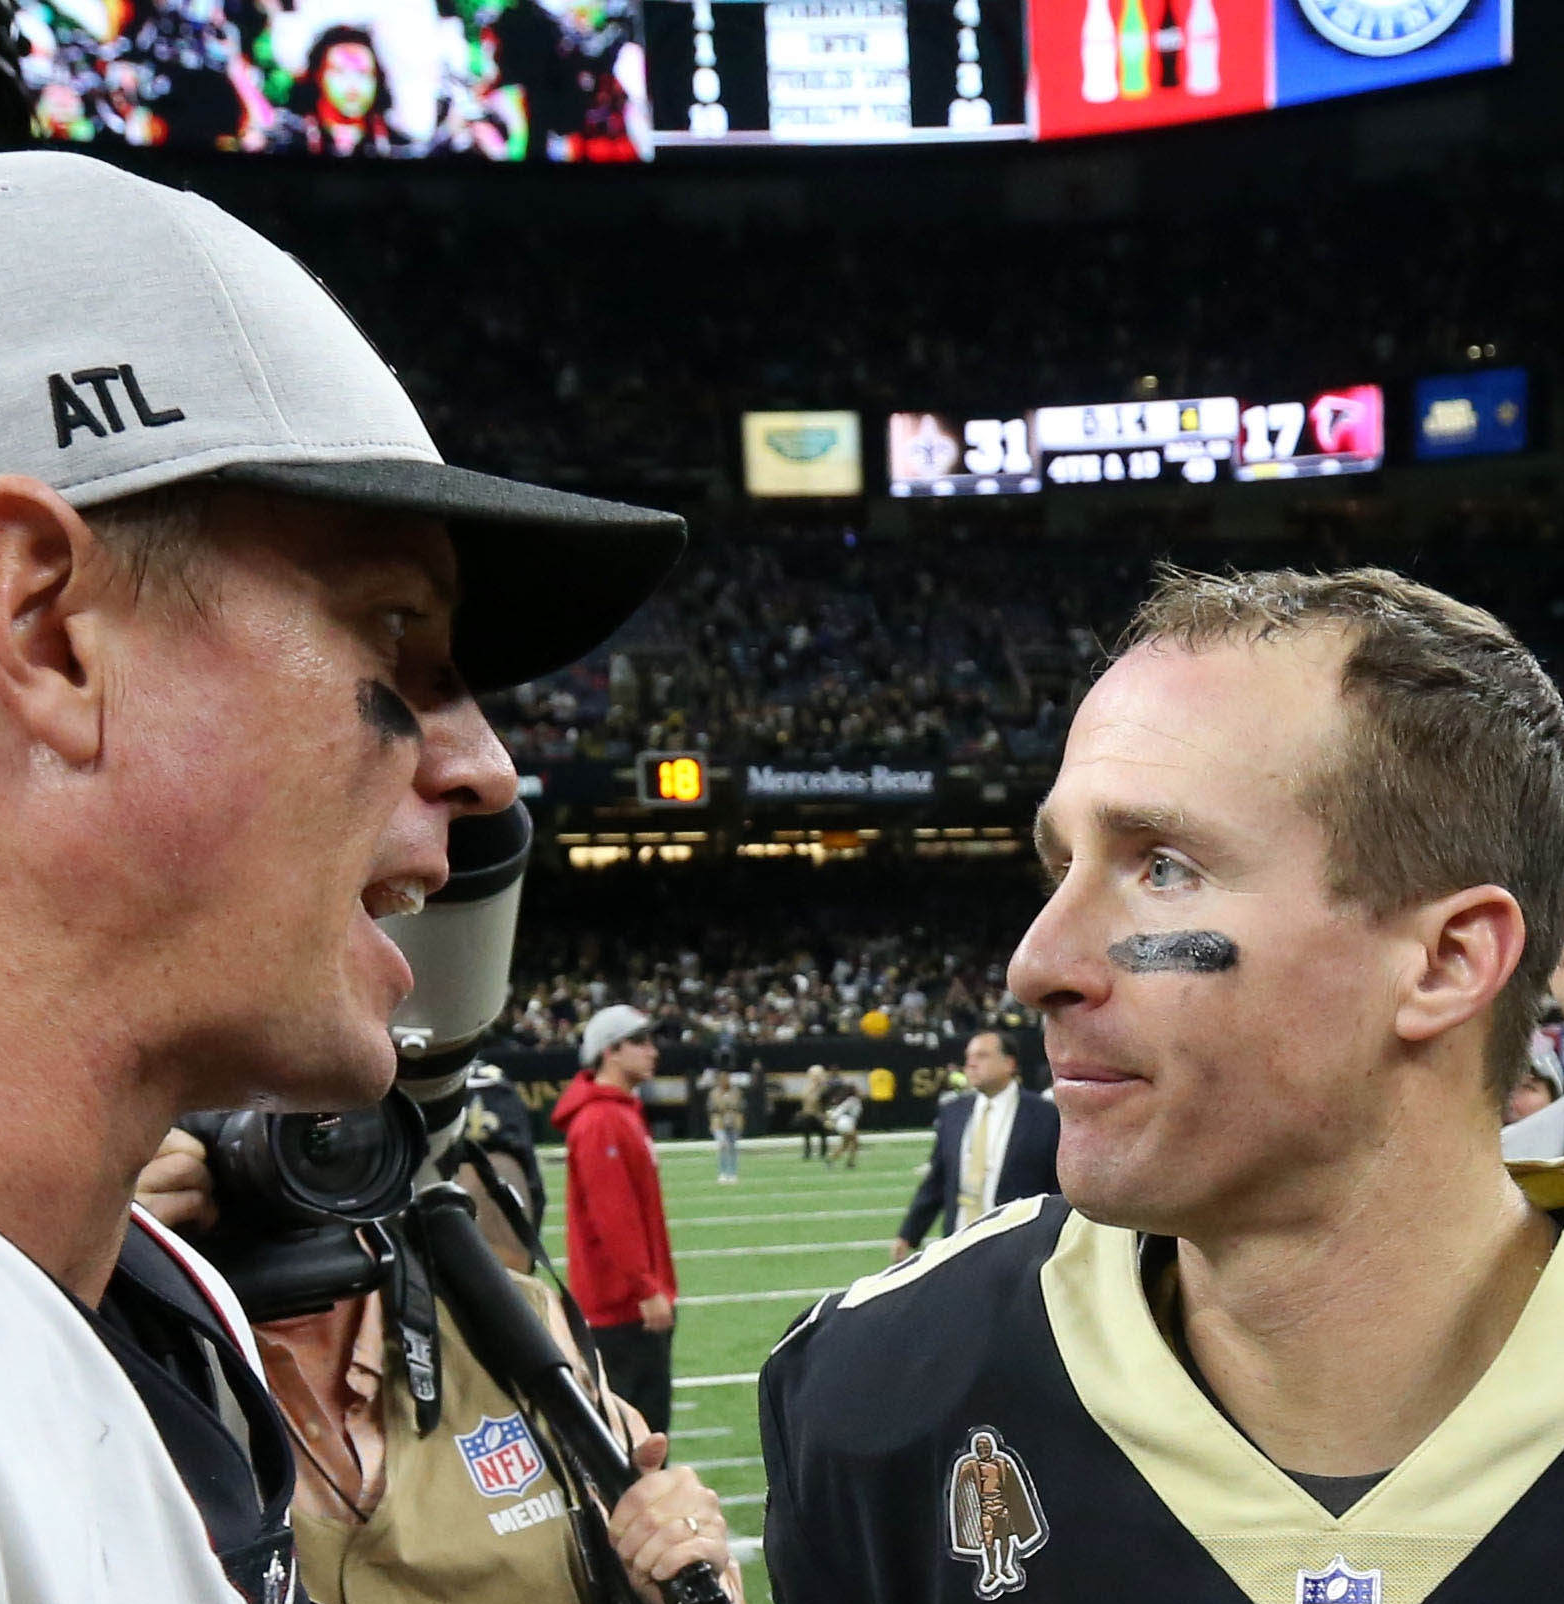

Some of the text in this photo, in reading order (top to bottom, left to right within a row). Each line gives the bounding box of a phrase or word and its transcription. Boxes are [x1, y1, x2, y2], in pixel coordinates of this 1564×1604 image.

[48, 364, 185, 449] ATL
[1241, 402, 1305, 462] 17
[964, 418, 1033, 476] 31
[747, 764, 933, 795] Mercedes-Benz
[473, 1442, 537, 1489] NFL
